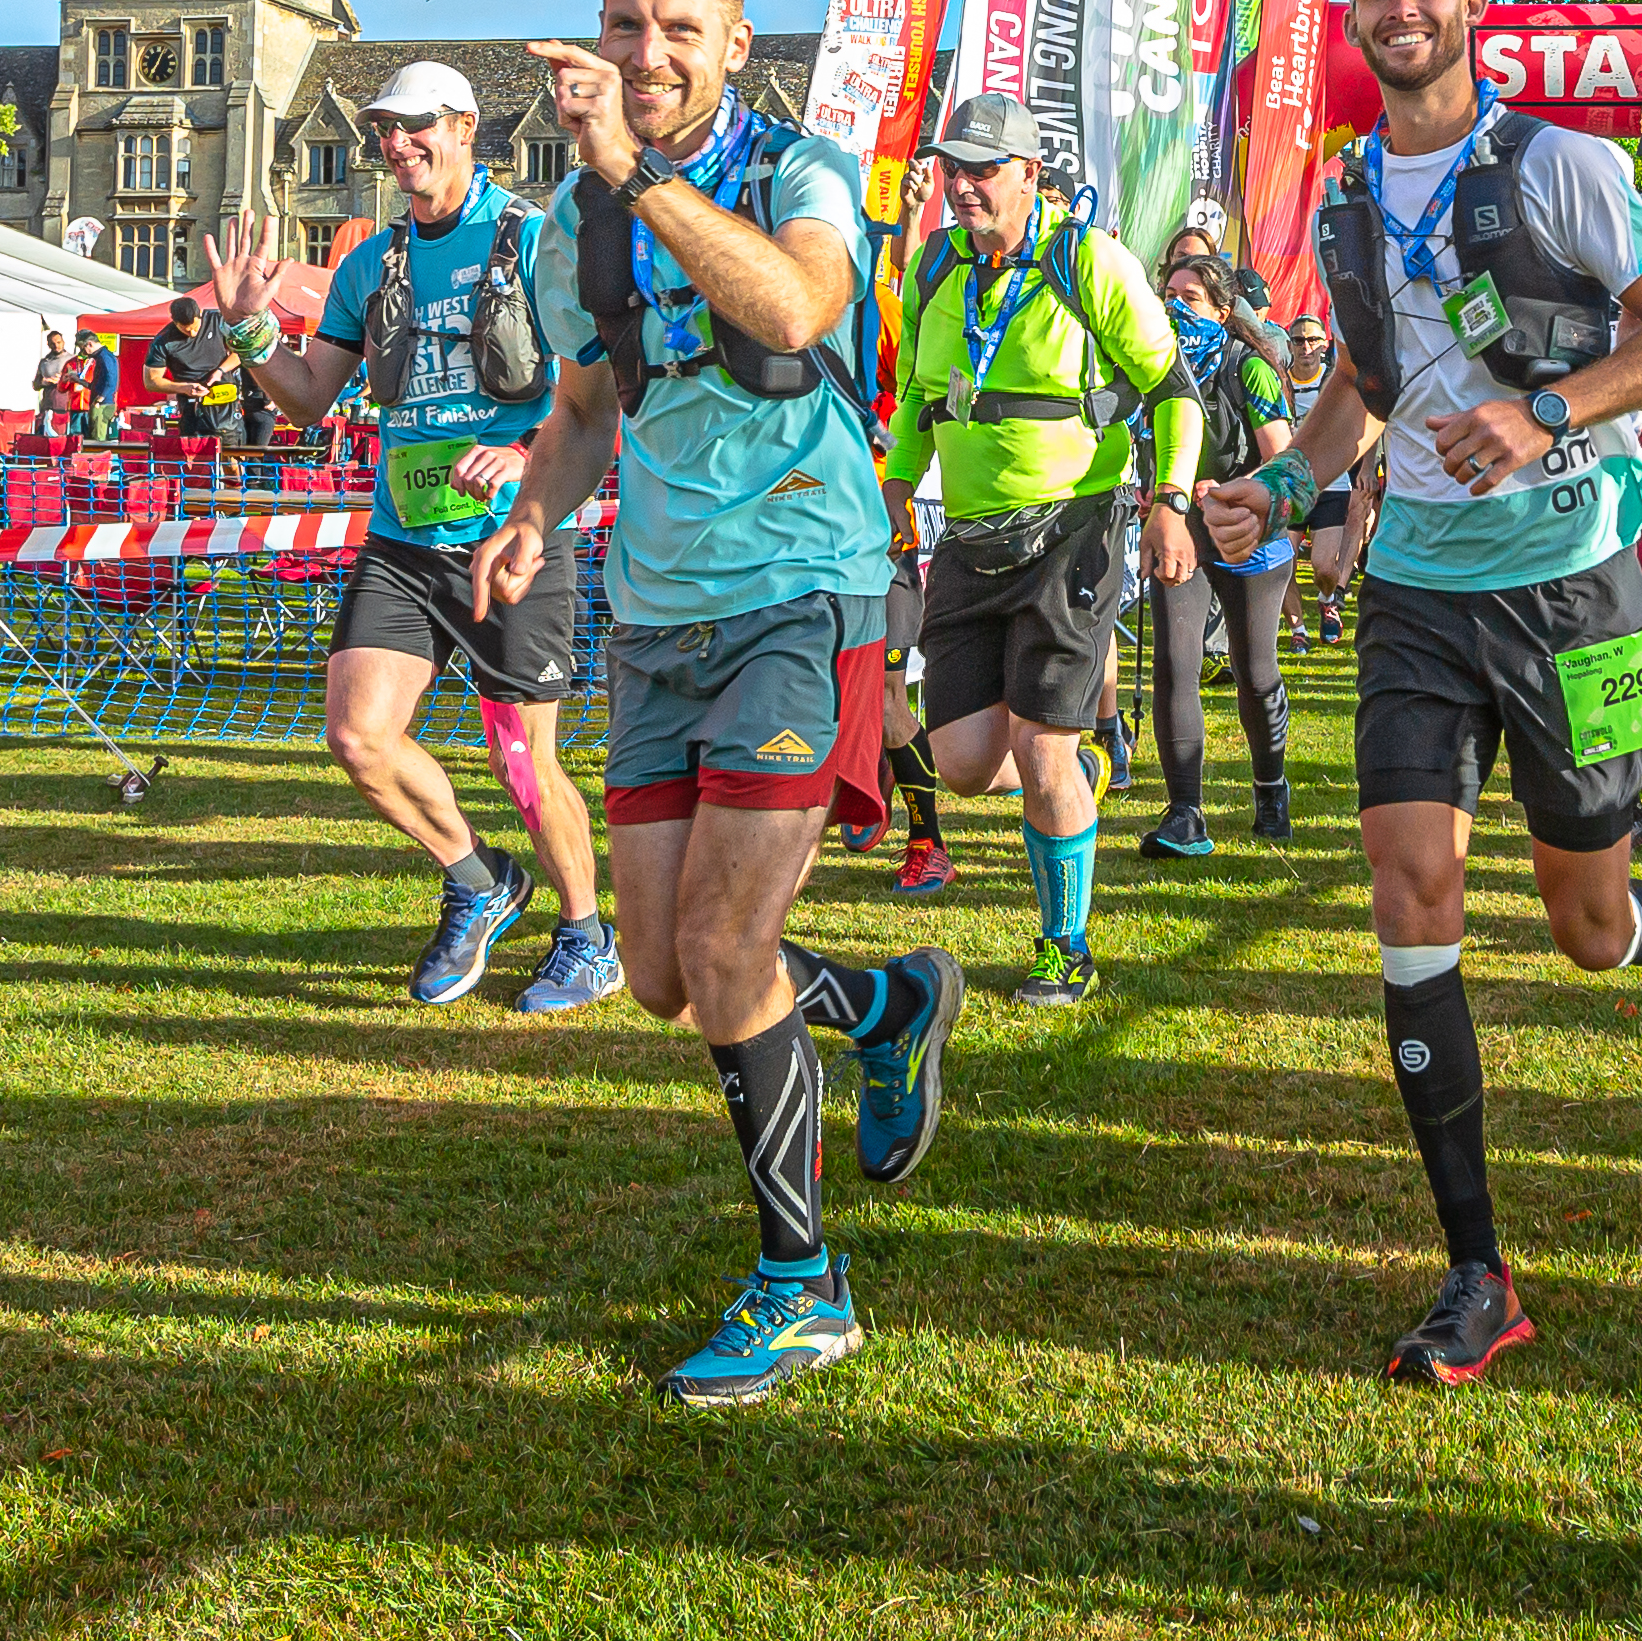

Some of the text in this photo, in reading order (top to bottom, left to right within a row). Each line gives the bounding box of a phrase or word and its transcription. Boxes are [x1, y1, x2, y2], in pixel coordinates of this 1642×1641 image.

[849, 18, 902, 34] CHALLENG
[850, 34, 872, 45] WALK
[902, 19, 926, 102] YOURSELF
[849, 72, 881, 103] ULTRA
[1265, 55, 1286, 110] Beat
[820, 106, 853, 125] ULTRA
[1029, 72, 1082, 176] LIVES
[1207, 120, 1222, 179] CHARITY
[427, 295, 470, 319] WEST
[405, 372, 468, 399] ALLENGE
[424, 404, 498, 426] Finisher
[402, 464, 452, 491] 1057
[796, 488, 828, 500] TRAIL
[1563, 645, 1625, 670] Vaughan, W
[756, 753, 816, 764] NIKE TRAIL
